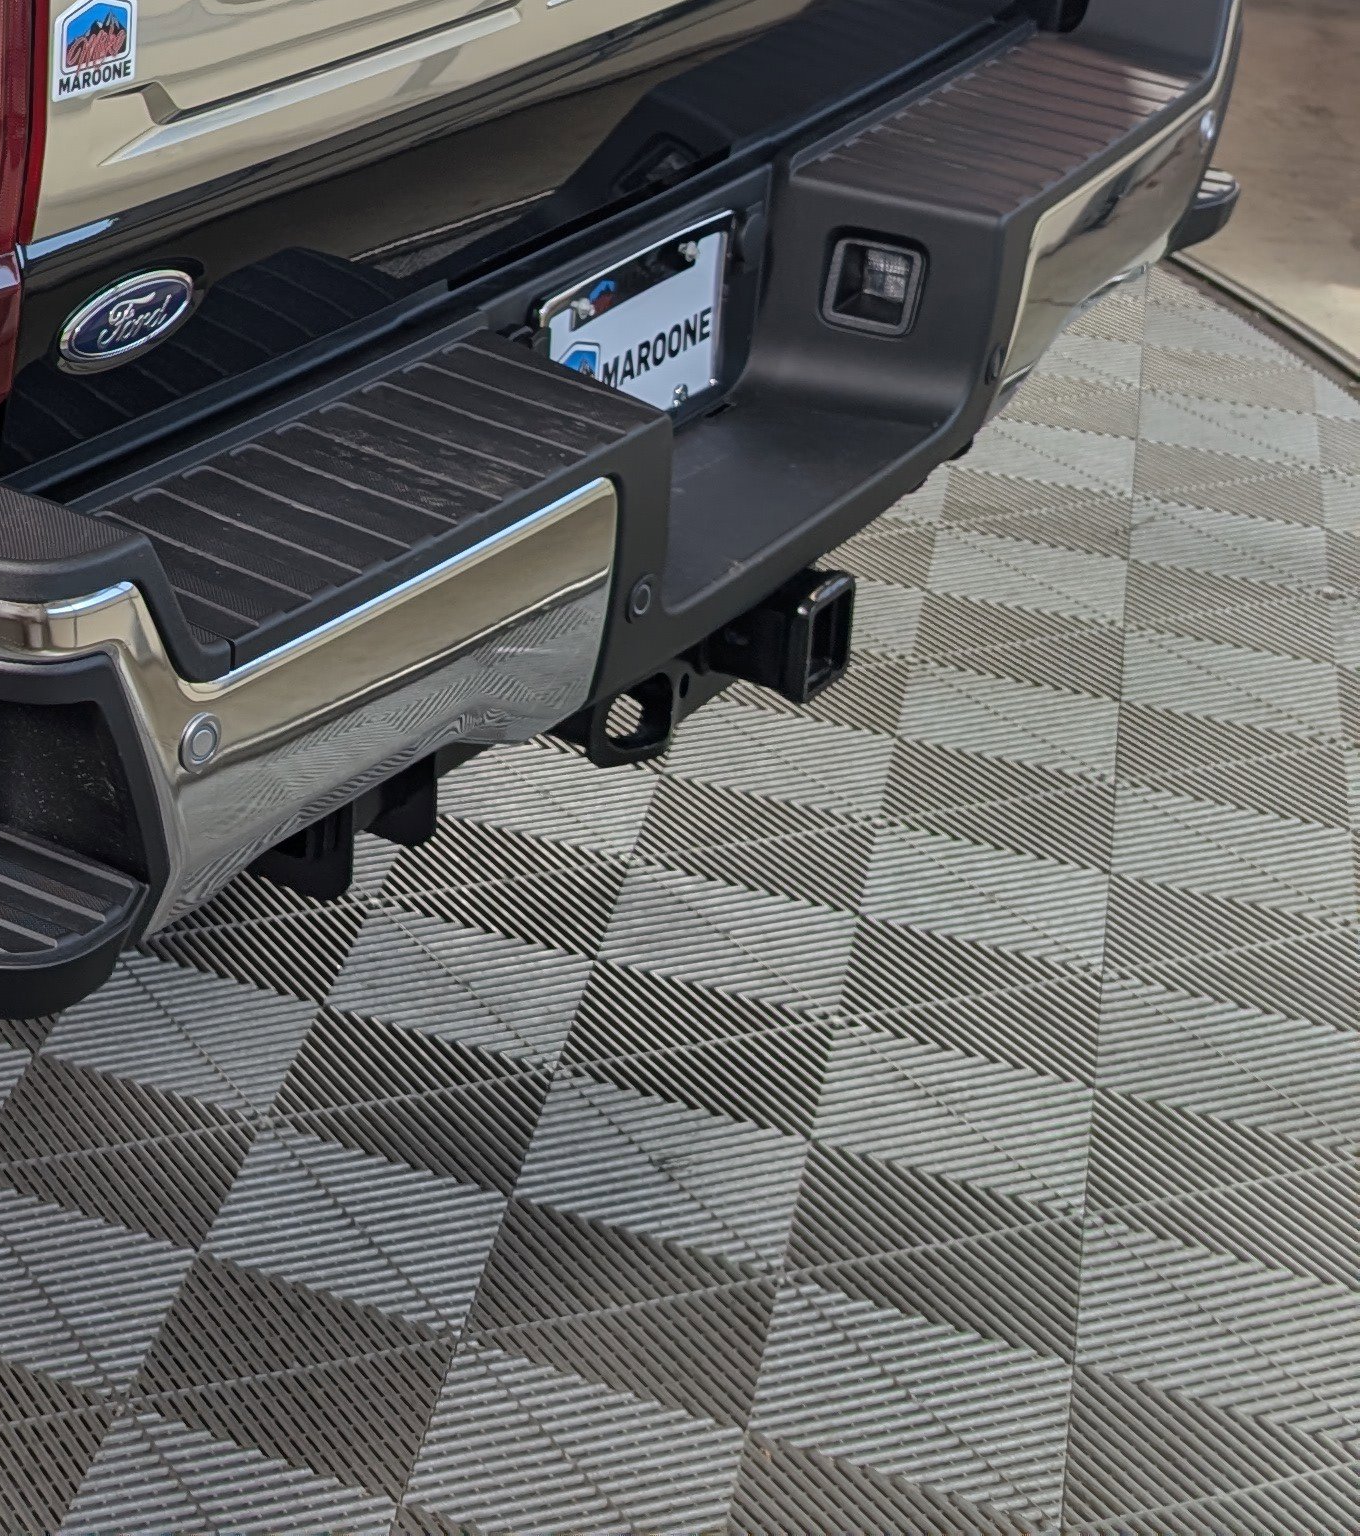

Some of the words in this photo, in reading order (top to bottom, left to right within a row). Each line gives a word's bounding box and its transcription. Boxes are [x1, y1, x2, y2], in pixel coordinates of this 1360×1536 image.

[58, 59, 132, 96] MAROONE
[96, 291, 173, 351] Ford
[602, 307, 713, 389] MAROONE
